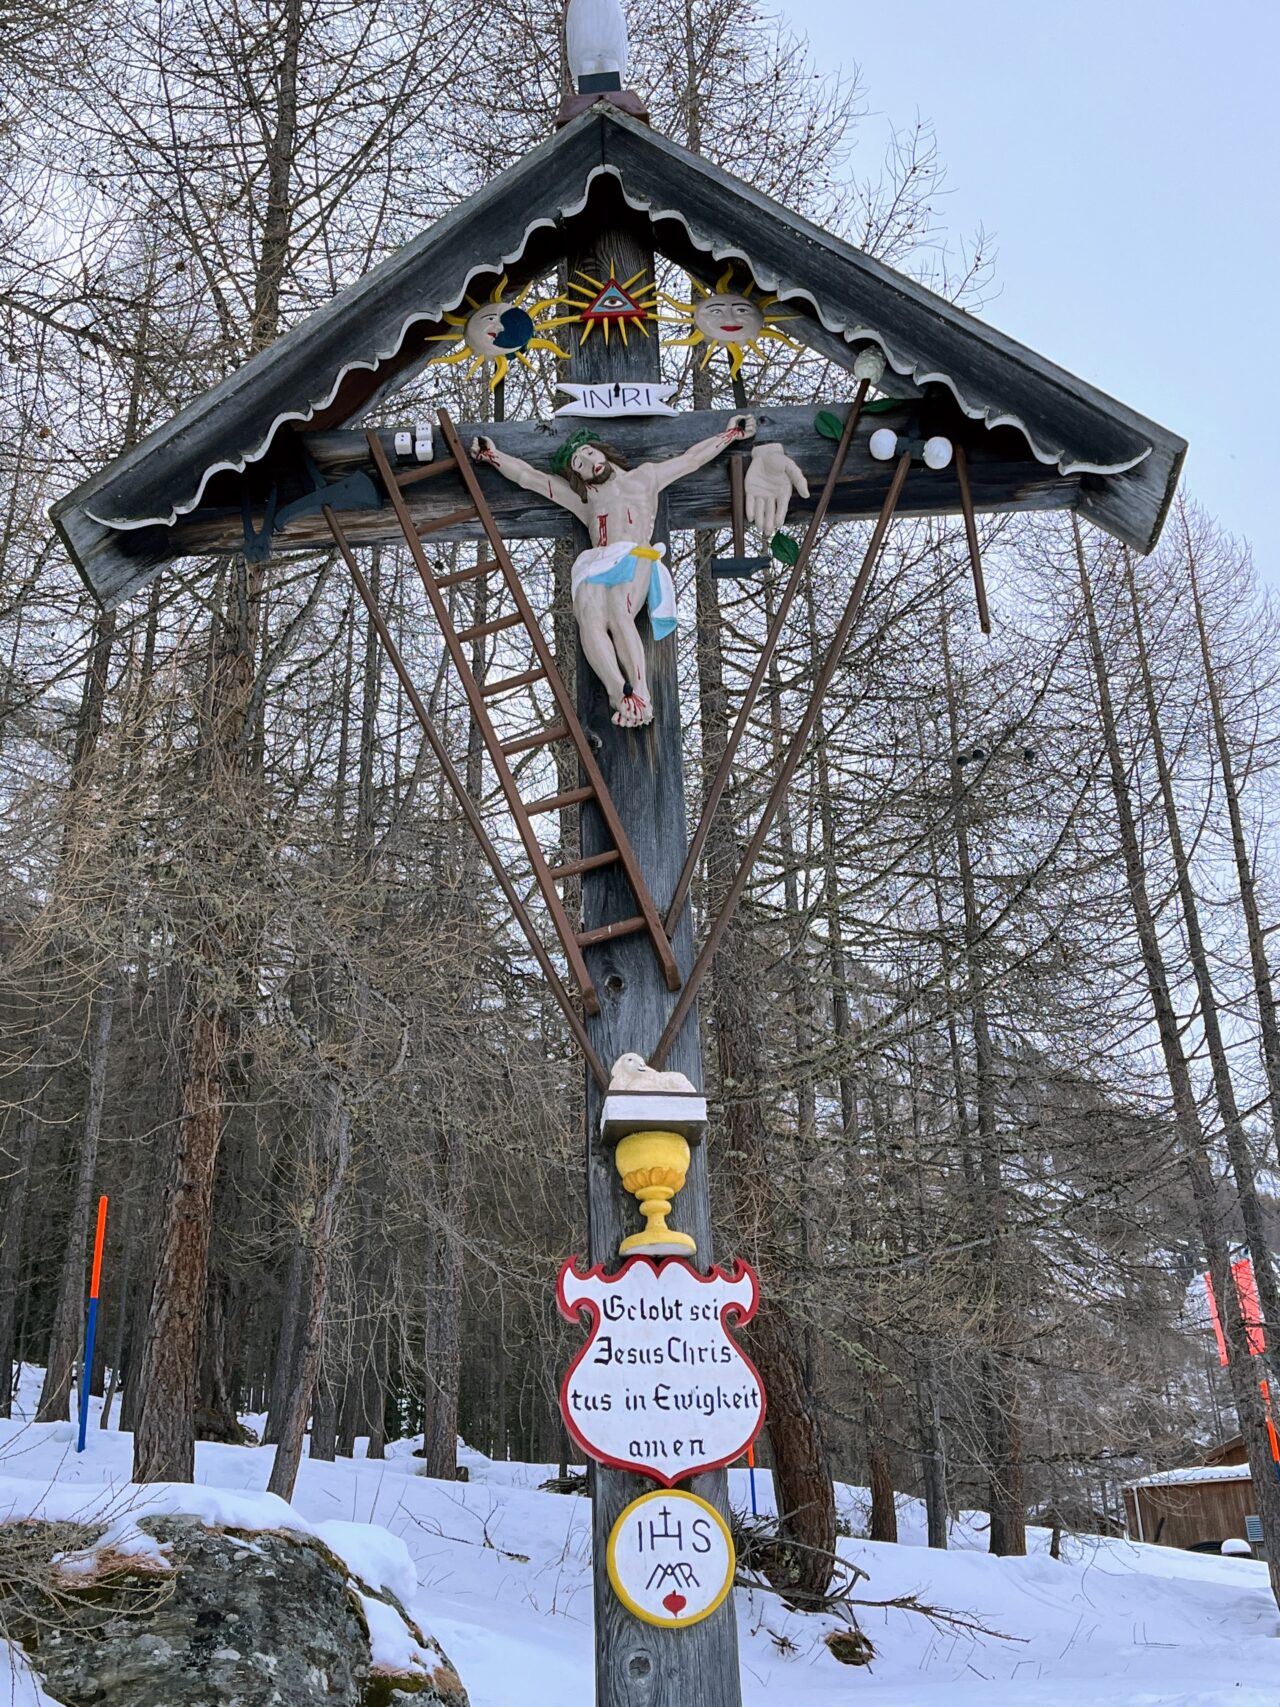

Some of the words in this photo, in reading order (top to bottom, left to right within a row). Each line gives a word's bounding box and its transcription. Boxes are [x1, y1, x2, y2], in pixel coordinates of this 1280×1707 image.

[583, 388, 651, 409] INRI
[602, 1295, 683, 1321] Gelobt
[689, 1298, 719, 1321] sei
[593, 1336, 664, 1365] Jesus
[571, 1389, 612, 1411] tus
[625, 1388, 647, 1411] in
[653, 1383, 759, 1416] Ewigkeit
[629, 1438, 706, 1458] amen
[638, 1506, 711, 1553] IHS
